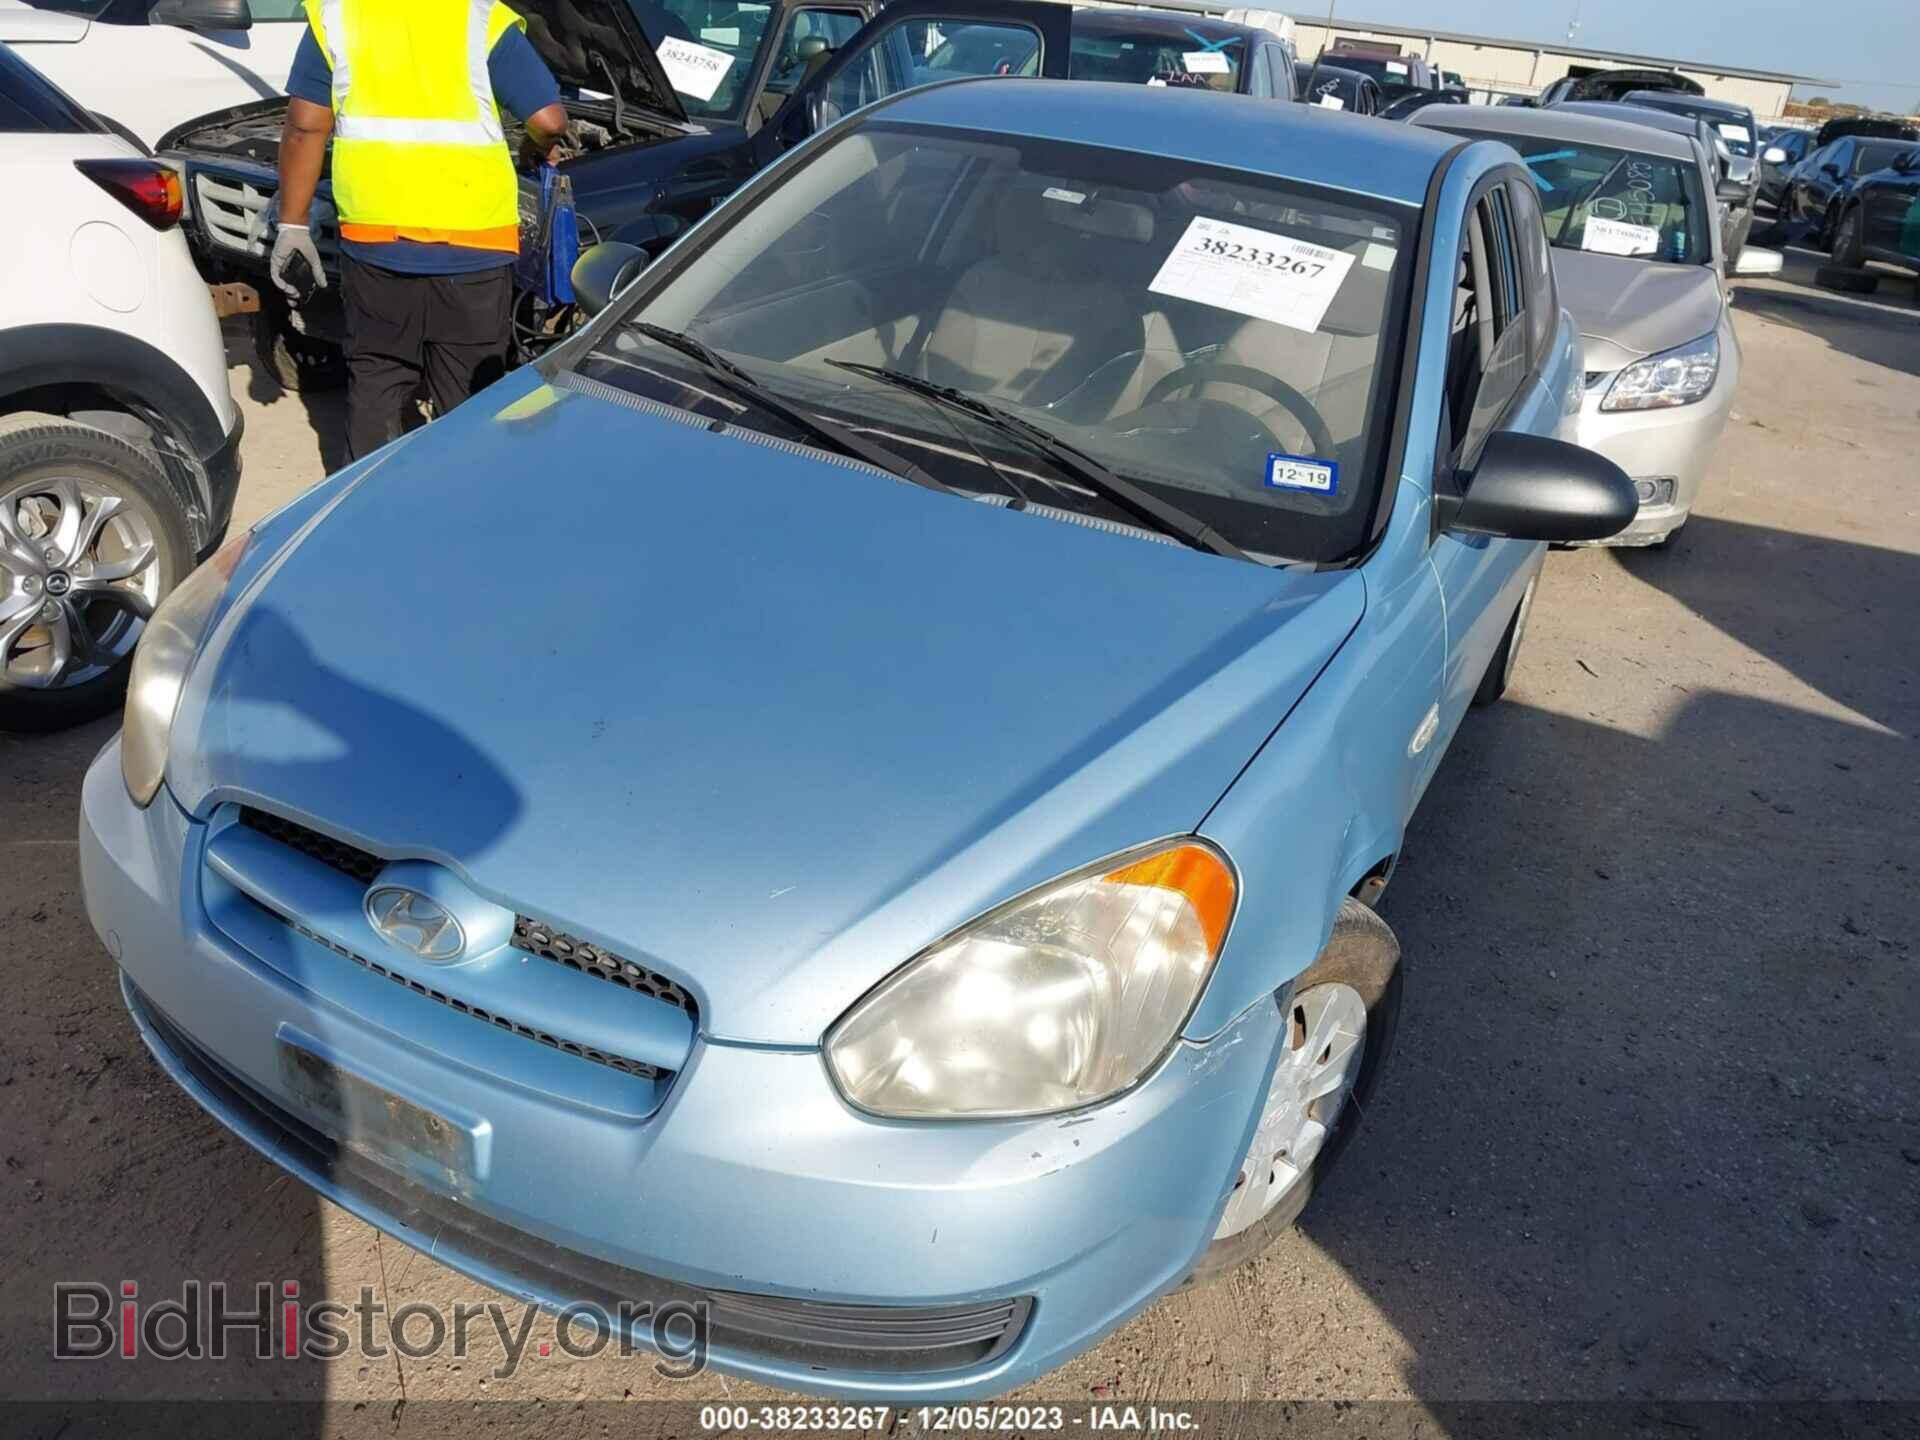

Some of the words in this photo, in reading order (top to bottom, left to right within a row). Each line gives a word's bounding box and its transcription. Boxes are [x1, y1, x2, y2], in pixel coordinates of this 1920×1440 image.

[1193, 236, 1326, 278] 38233267
[1276, 467, 1297, 481] 12
[1307, 472, 1328, 485] 19
